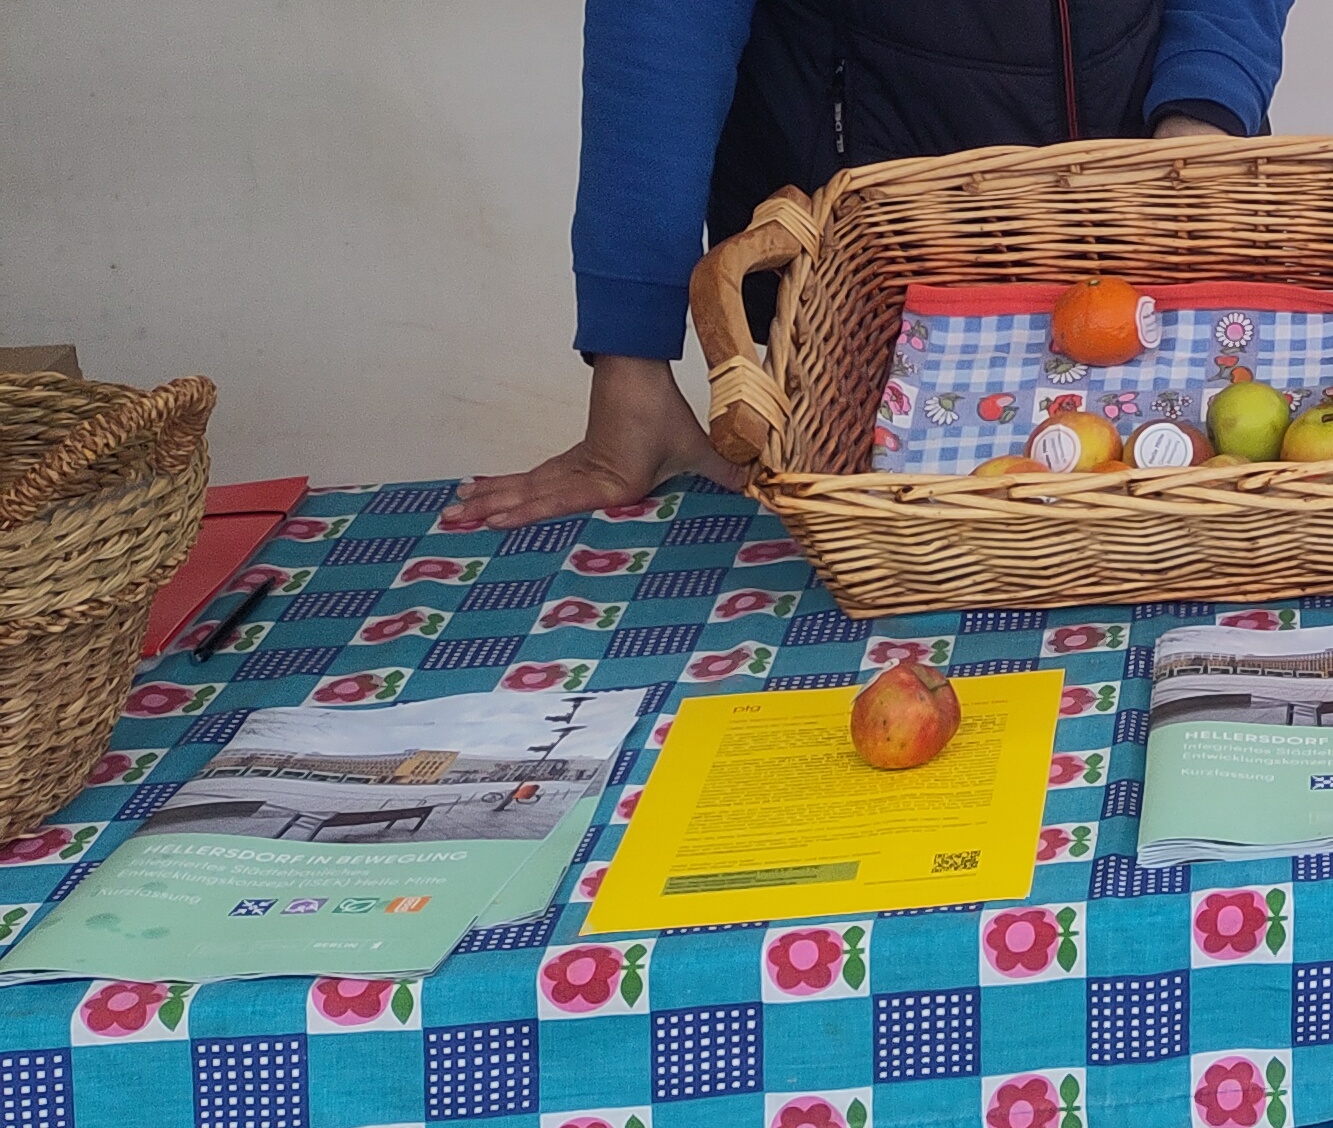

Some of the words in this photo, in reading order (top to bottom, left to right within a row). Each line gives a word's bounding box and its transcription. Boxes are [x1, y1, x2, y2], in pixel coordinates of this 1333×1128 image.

[1185, 730, 1329, 745] HELLERSDORF
[1183, 743, 1271, 756] Integriertes
[1181, 767, 1275, 782] Kurzfassung
[144, 844, 306, 865] HELLERSDORF
[307, 855, 327, 864] IN
[331, 851, 468, 865] BEWEGUNG
[98, 887, 202, 904] Kurzfassung
